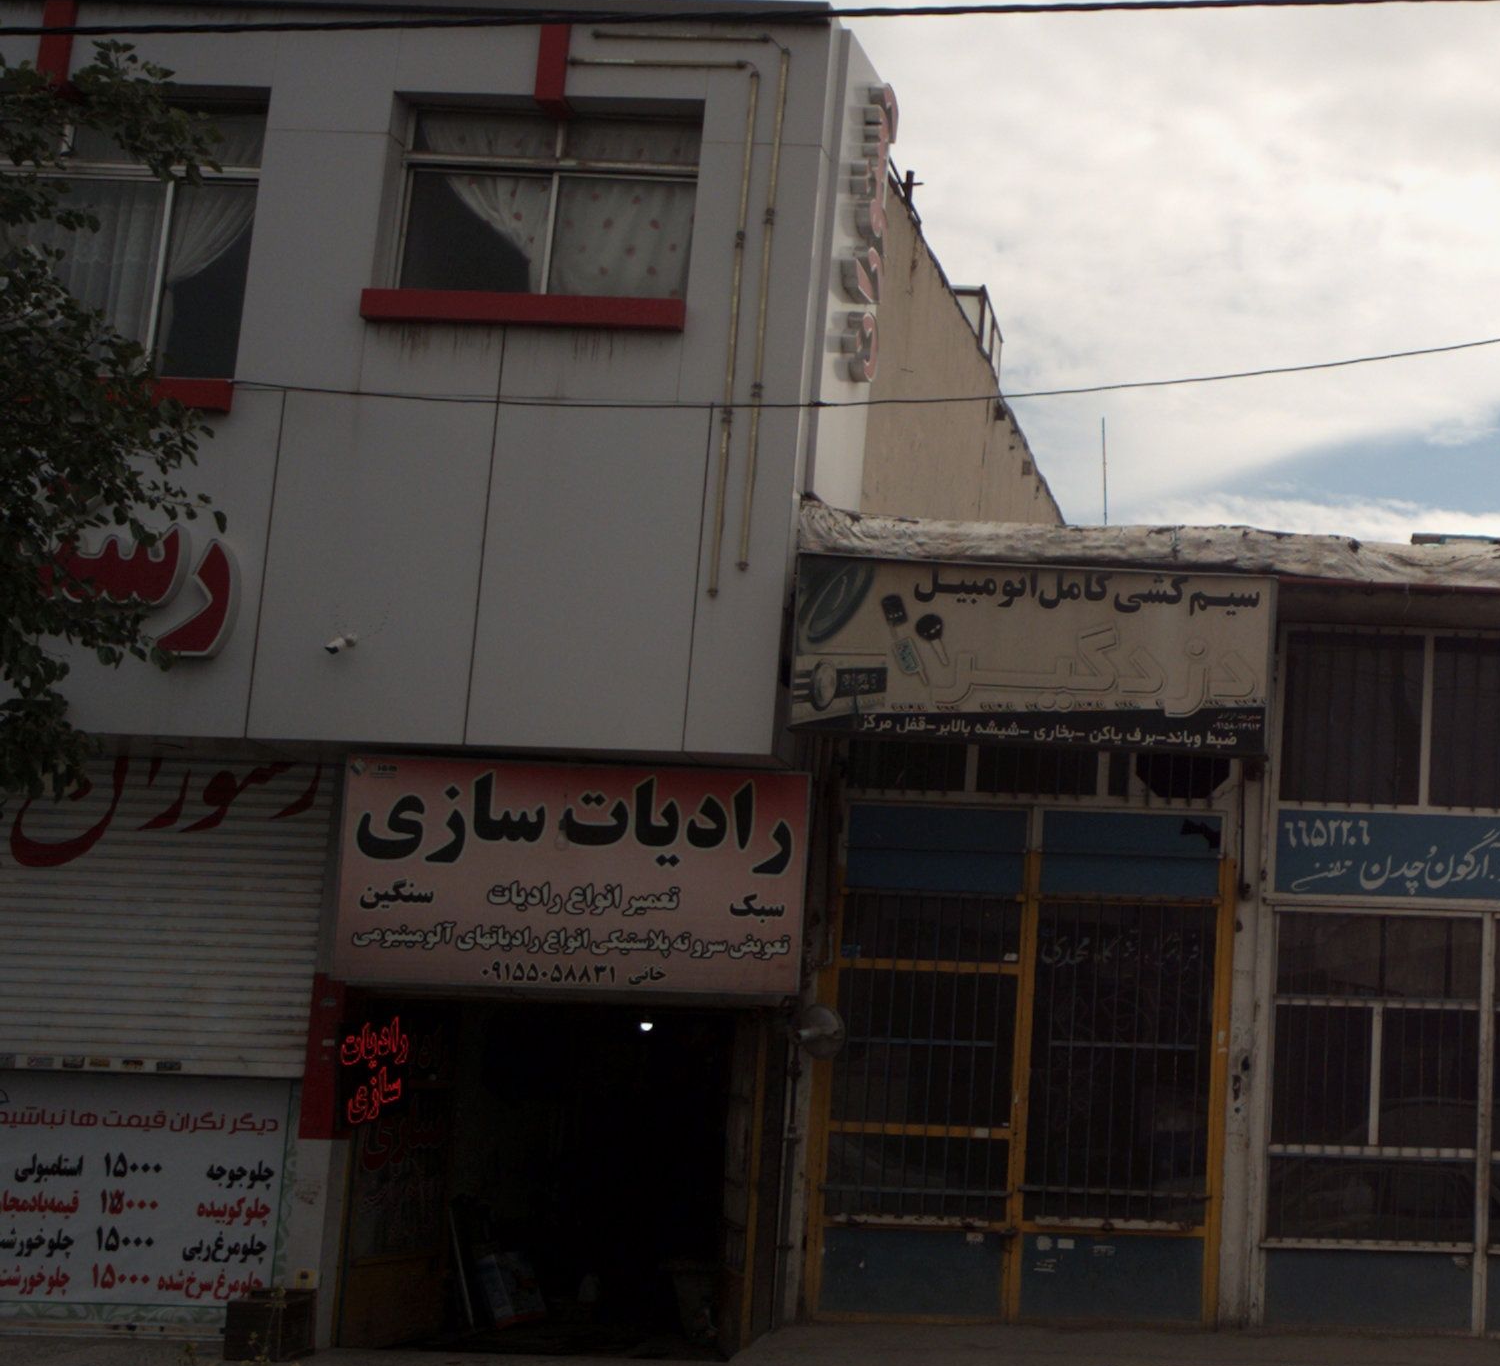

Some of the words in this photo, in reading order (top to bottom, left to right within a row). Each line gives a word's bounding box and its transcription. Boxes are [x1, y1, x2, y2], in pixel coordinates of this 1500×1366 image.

[1114, 576, 1189, 613] کشی
[1189, 588, 1261, 616] سیم
[1206, 730, 1238, 746] ضبط
[356, 770, 547, 864] سازی
[563, 777, 794, 875] رادیات
[359, 879, 434, 910] سنگین
[486, 879, 562, 915] رادیات
[566, 883, 623, 917] انواع
[622, 886, 681, 917] تعمیر
[729, 893, 786, 924] سبک
[543, 927, 591, 955] انواع
[590, 929, 671, 959] پلاستیکی
[671, 931, 692, 953] ته
[728, 934, 791, 961] تعویض
[628, 965, 667, 986] خانی
[340, 1015, 411, 1069] رادیات
[347, 1066, 402, 1125] سازی
[70, 1110, 98, 1127] ها
[102, 1109, 167, 1133] قیمت
[169, 1111, 225, 1134] نگران
[229, 1112, 279, 1135] دیگر
[104, 1152, 162, 1178] ۱۵۰۰۰
[97, 1226, 154, 1252] ۱۵۰۰۰
[92, 1263, 150, 1289] ۱۵۰۰۰
